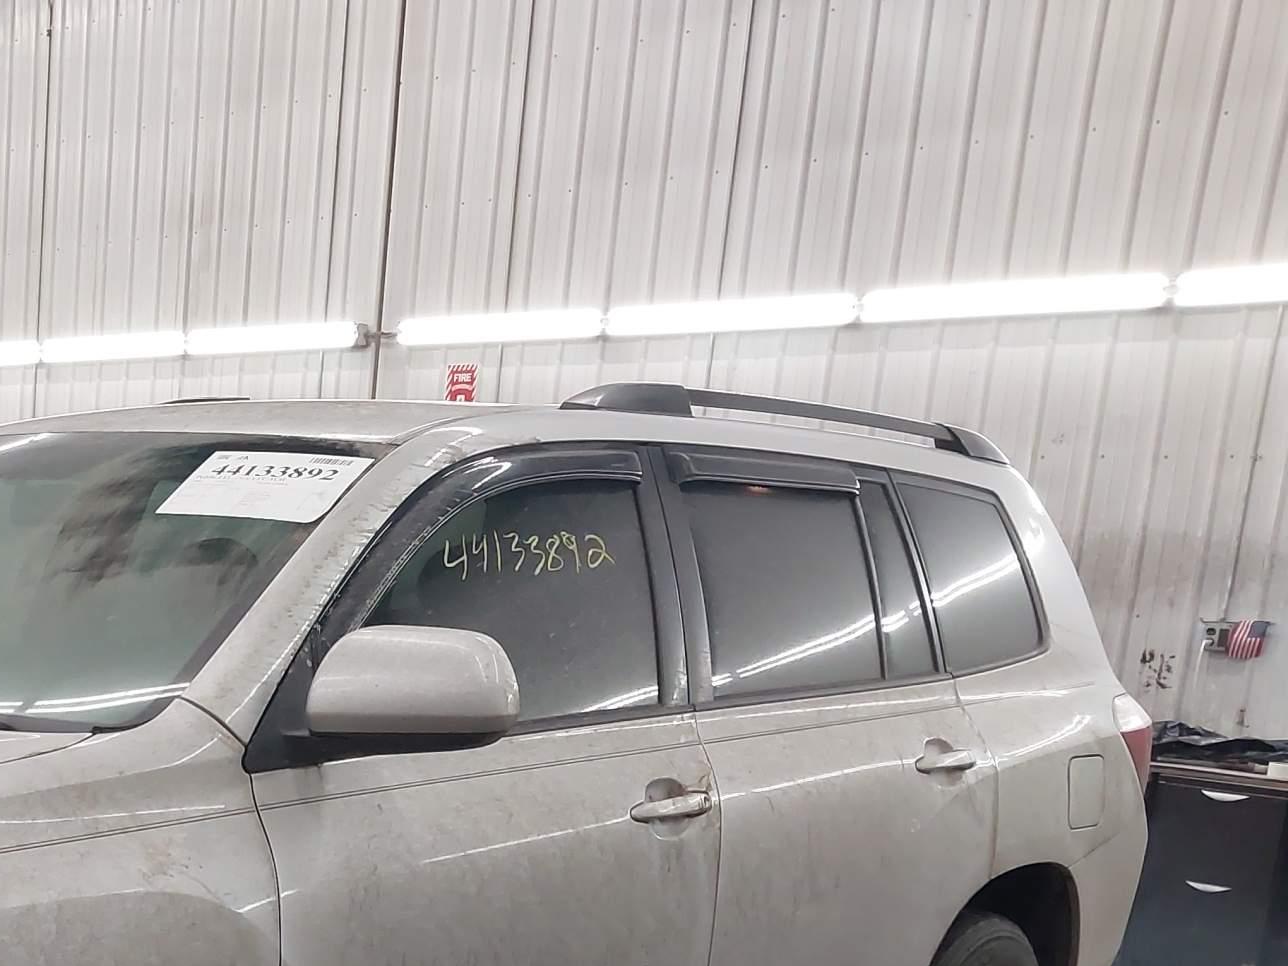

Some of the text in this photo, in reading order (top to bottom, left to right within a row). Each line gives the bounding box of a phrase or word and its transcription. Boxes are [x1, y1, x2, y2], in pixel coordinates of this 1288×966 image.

[453, 372, 473, 383] FIRE
[211, 463, 340, 482] 44133892
[444, 530, 615, 581] 44133892
